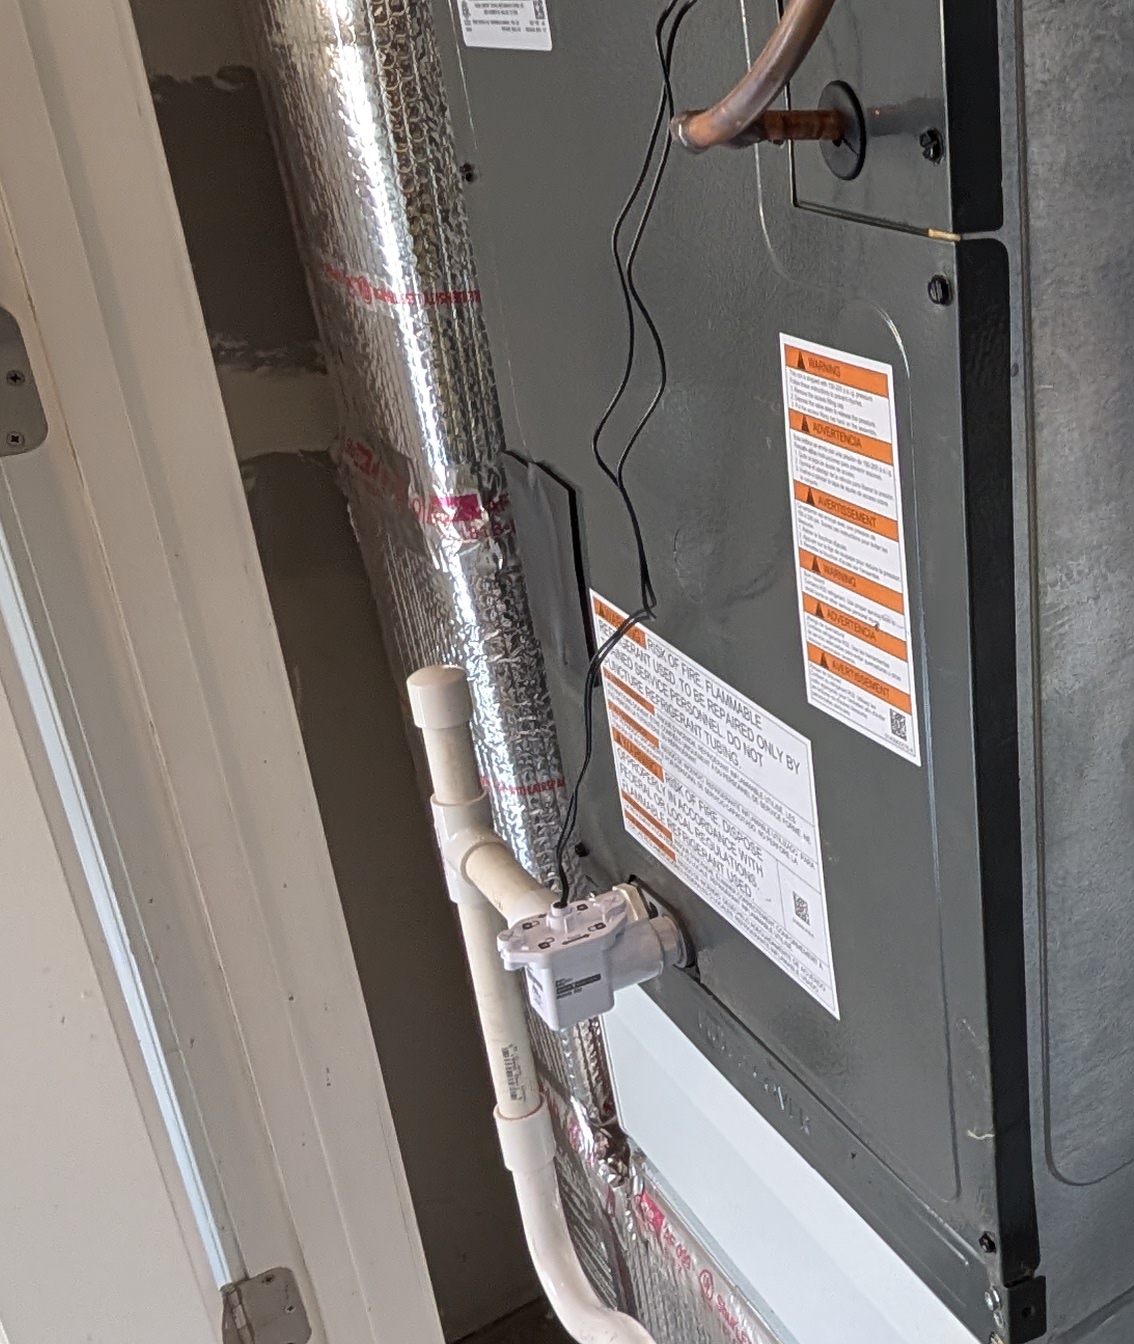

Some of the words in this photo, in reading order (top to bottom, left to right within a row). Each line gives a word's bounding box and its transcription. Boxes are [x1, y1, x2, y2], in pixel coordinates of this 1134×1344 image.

[807, 356, 840, 377] WARNING
[812, 421, 862, 449] ADVERTENCIA
[818, 495, 877, 528] AVERTISSEMENT
[823, 563, 856, 588] WARNING
[827, 608, 876, 642] ADVERTENCIA
[634, 660, 669, 699] SERVICE
[725, 727, 742, 753] DO
[741, 739, 765, 770] NOT
[646, 637, 666, 664] RISK
[666, 650, 680, 674] OF
[704, 677, 763, 732] FLAMMABLE
[831, 659, 890, 699] AVERTISSEMENT
[644, 683, 703, 741] REFRIGERANT
[703, 728, 741, 770] TUBING.
[678, 676, 693, 700] TO
[692, 686, 706, 710] BE
[706, 695, 755, 745] REPAIRED
[754, 730, 785, 766] ONLY
[784, 752, 802, 779] BY
[618, 761, 653, 801] FEDERAL
[653, 789, 666, 813] OR
[666, 800, 693, 836] LOCAL
[693, 823, 759, 892] REGULATIONS.
[663, 769, 684, 799] RISK
[683, 786, 697, 810] OF
[721, 816, 764, 864] DISPOSE
[665, 815, 725, 877] REFRIGERANT
[726, 867, 754, 903] USED.
[666, 787, 677, 807] IN
[677, 795, 738, 858] ACCORDANCE
[738, 846, 764, 880] WITH
